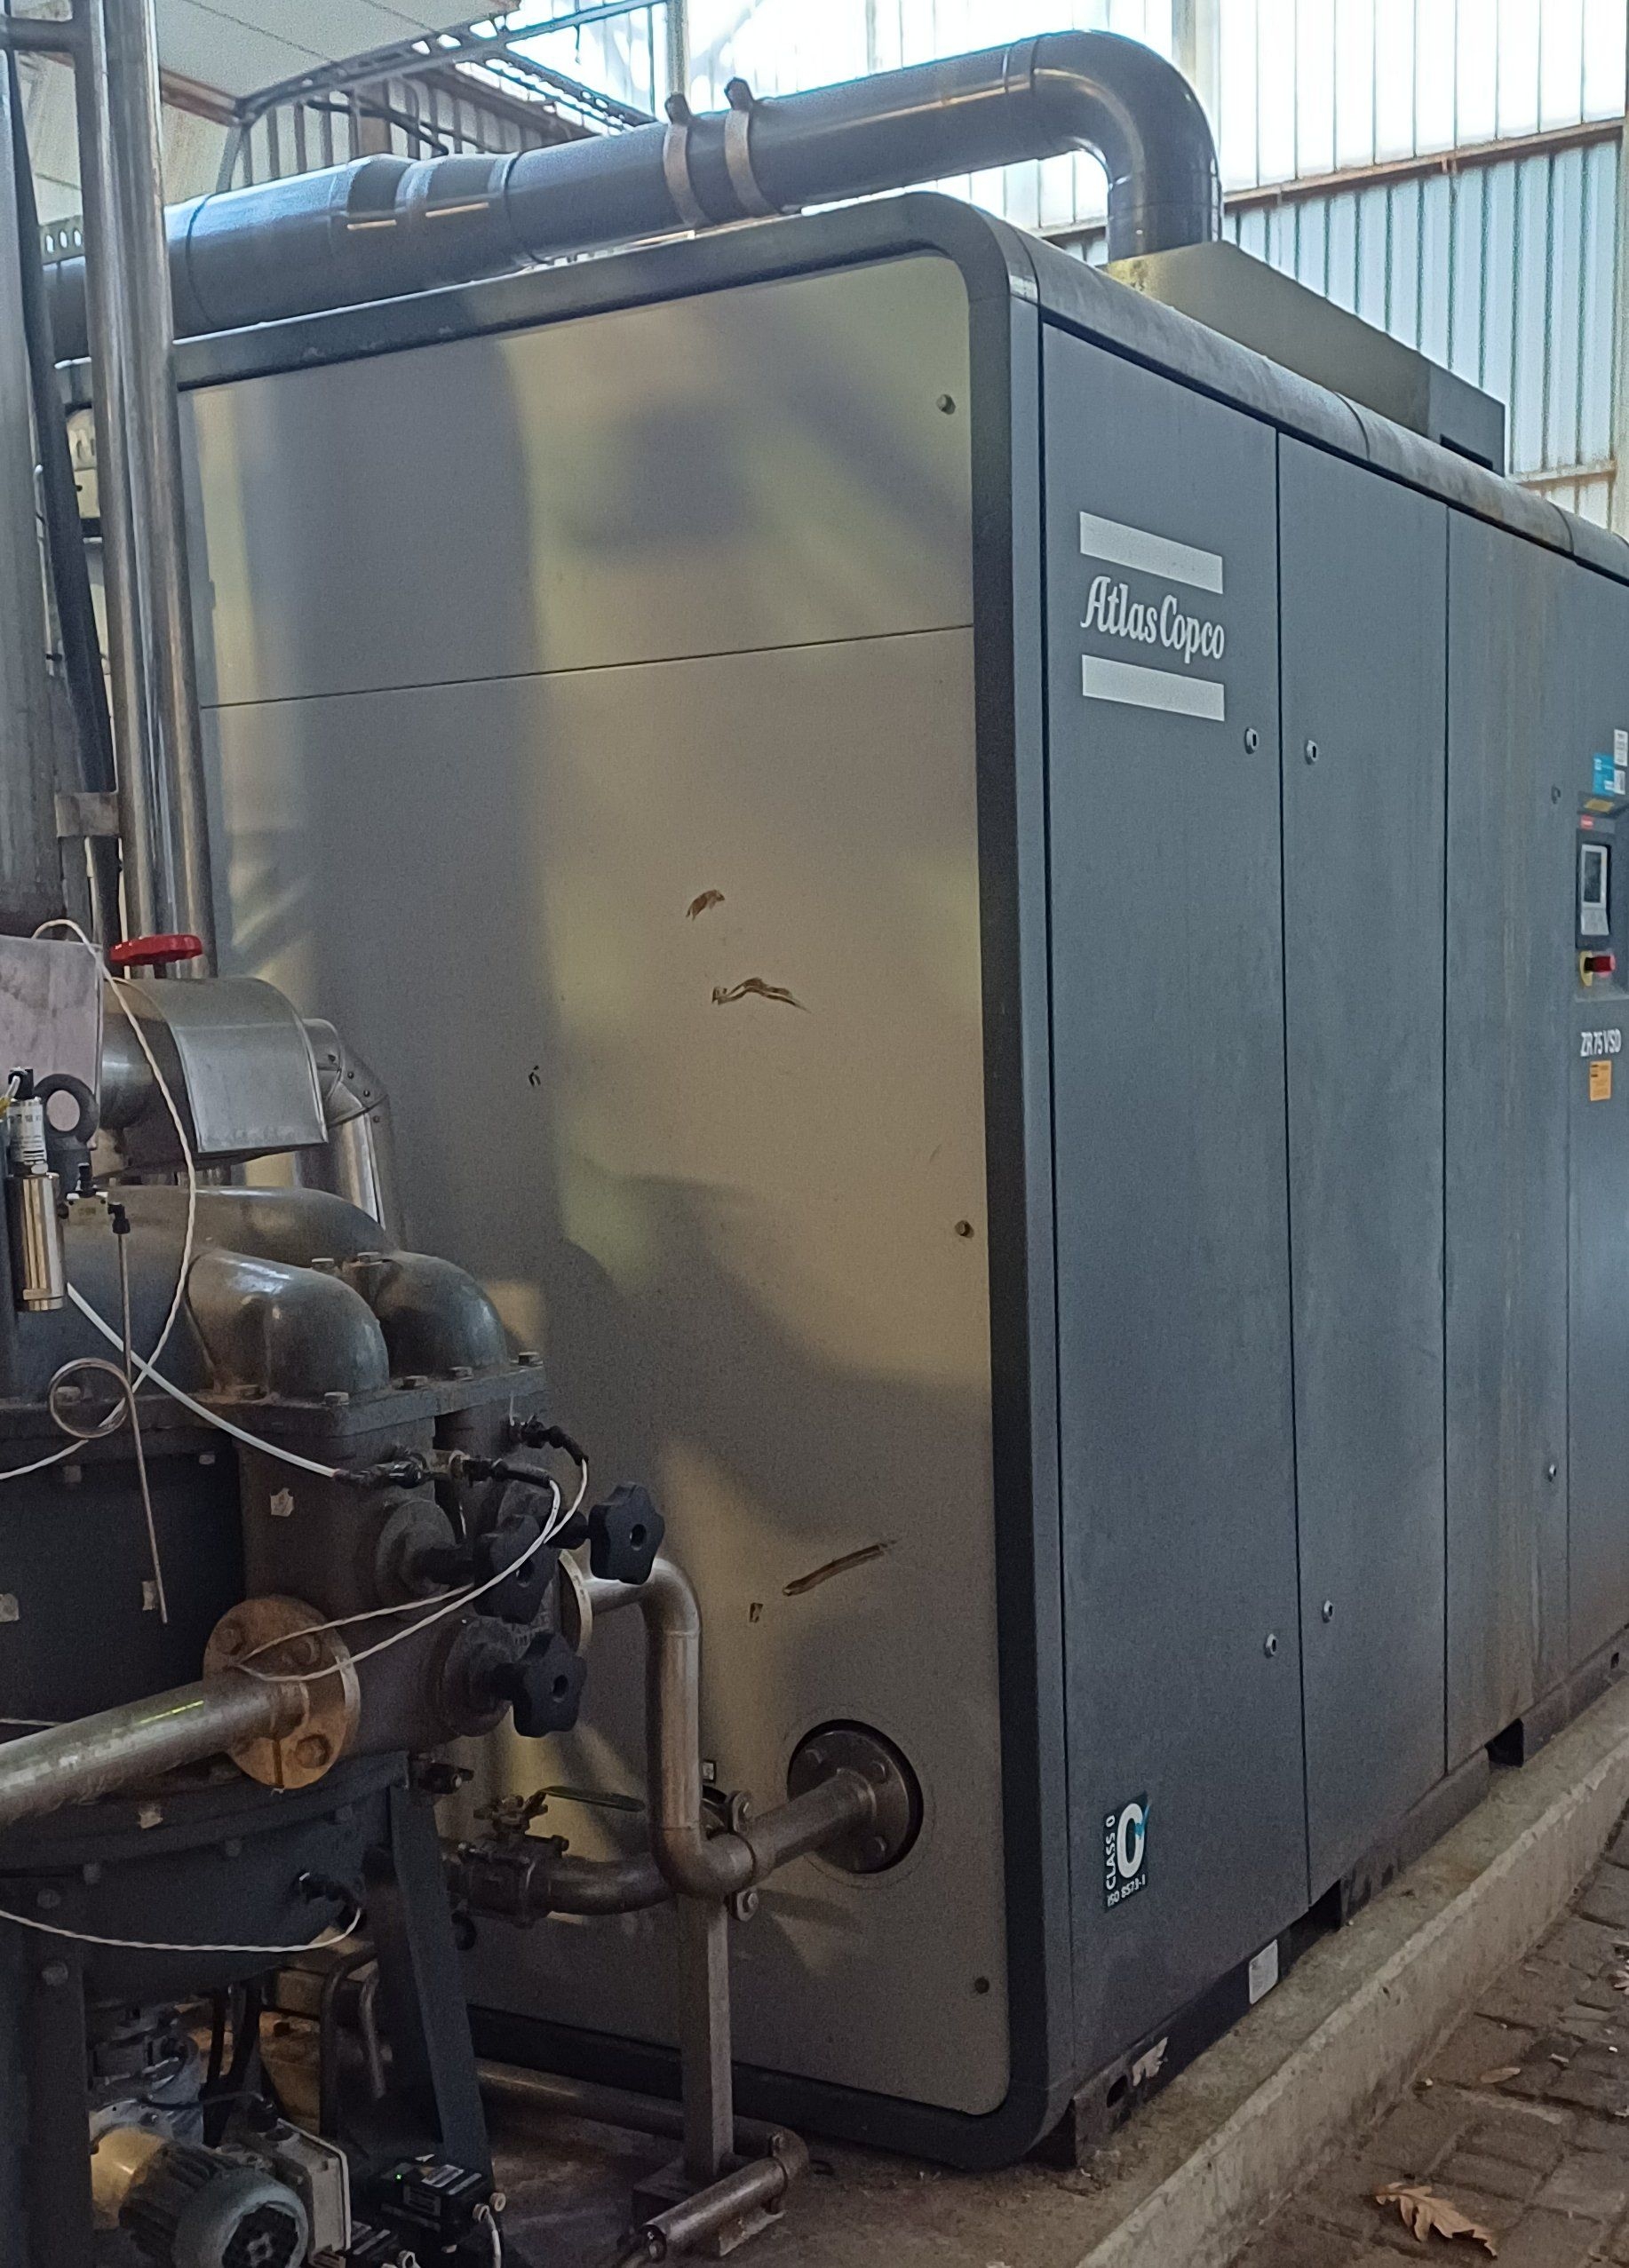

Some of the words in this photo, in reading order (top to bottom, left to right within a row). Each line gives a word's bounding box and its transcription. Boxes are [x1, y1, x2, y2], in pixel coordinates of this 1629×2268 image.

[1080, 575, 1157, 644] Atlas
[1160, 594, 1225, 664] Copco
[1580, 1031, 1593, 1057] ZR
[1593, 1031, 1603, 1055] 75
[1602, 1028, 1622, 1054] VSD
[1106, 1832, 1116, 1891] CLASS
[1107, 1890, 1120, 1907] ISO
